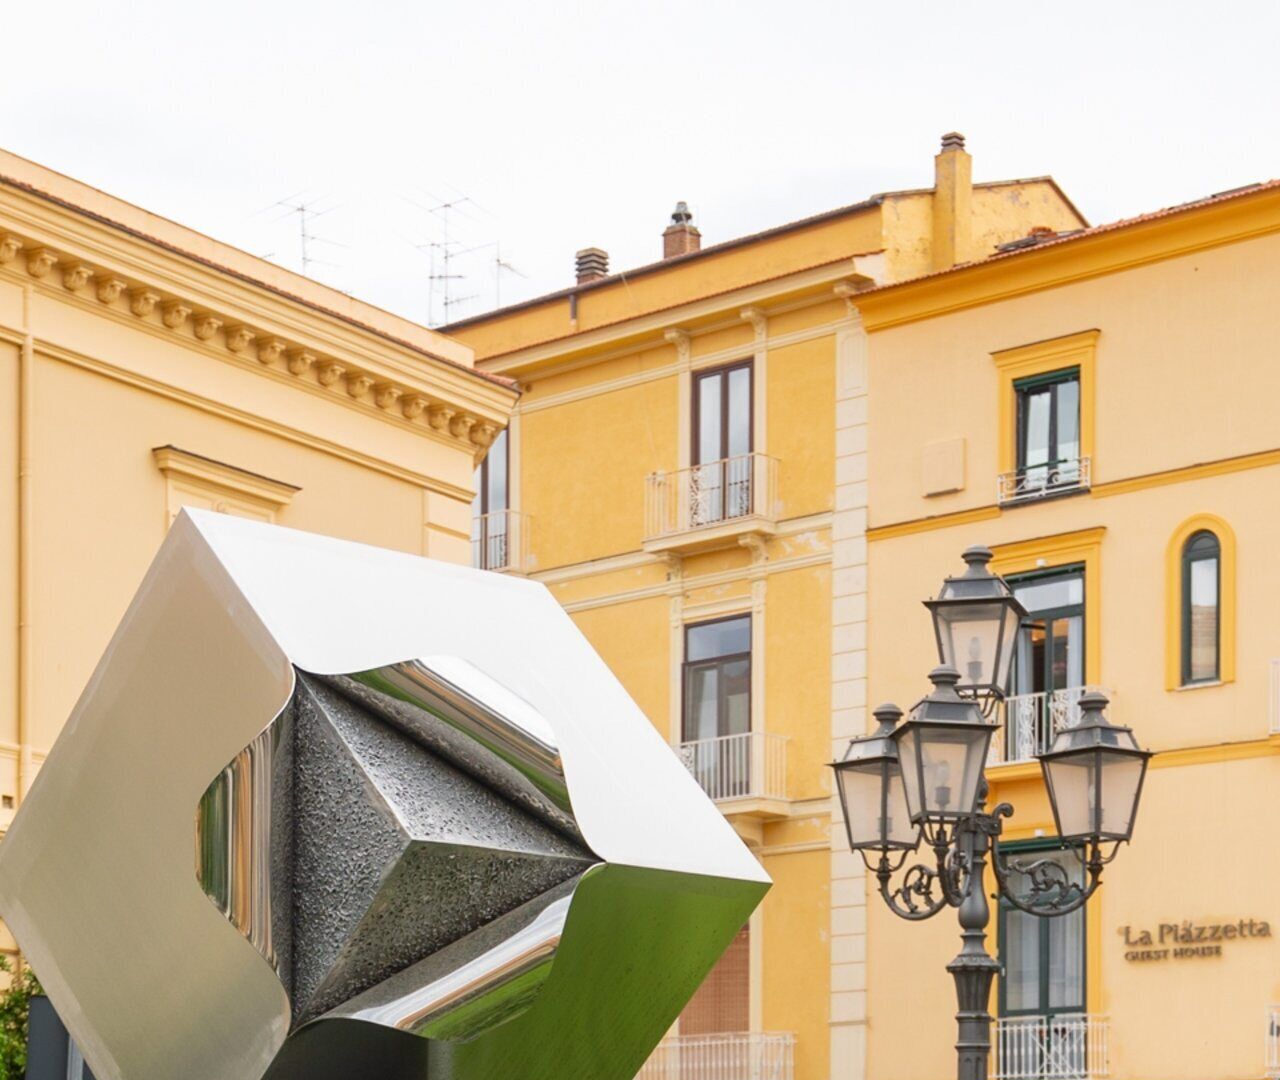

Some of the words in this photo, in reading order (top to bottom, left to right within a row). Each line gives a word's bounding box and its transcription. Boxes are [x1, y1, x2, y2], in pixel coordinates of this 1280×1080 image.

[1124, 926, 1153, 946] La
[1124, 949, 1170, 962] GUEST
[1173, 945, 1222, 960] HOUSE
